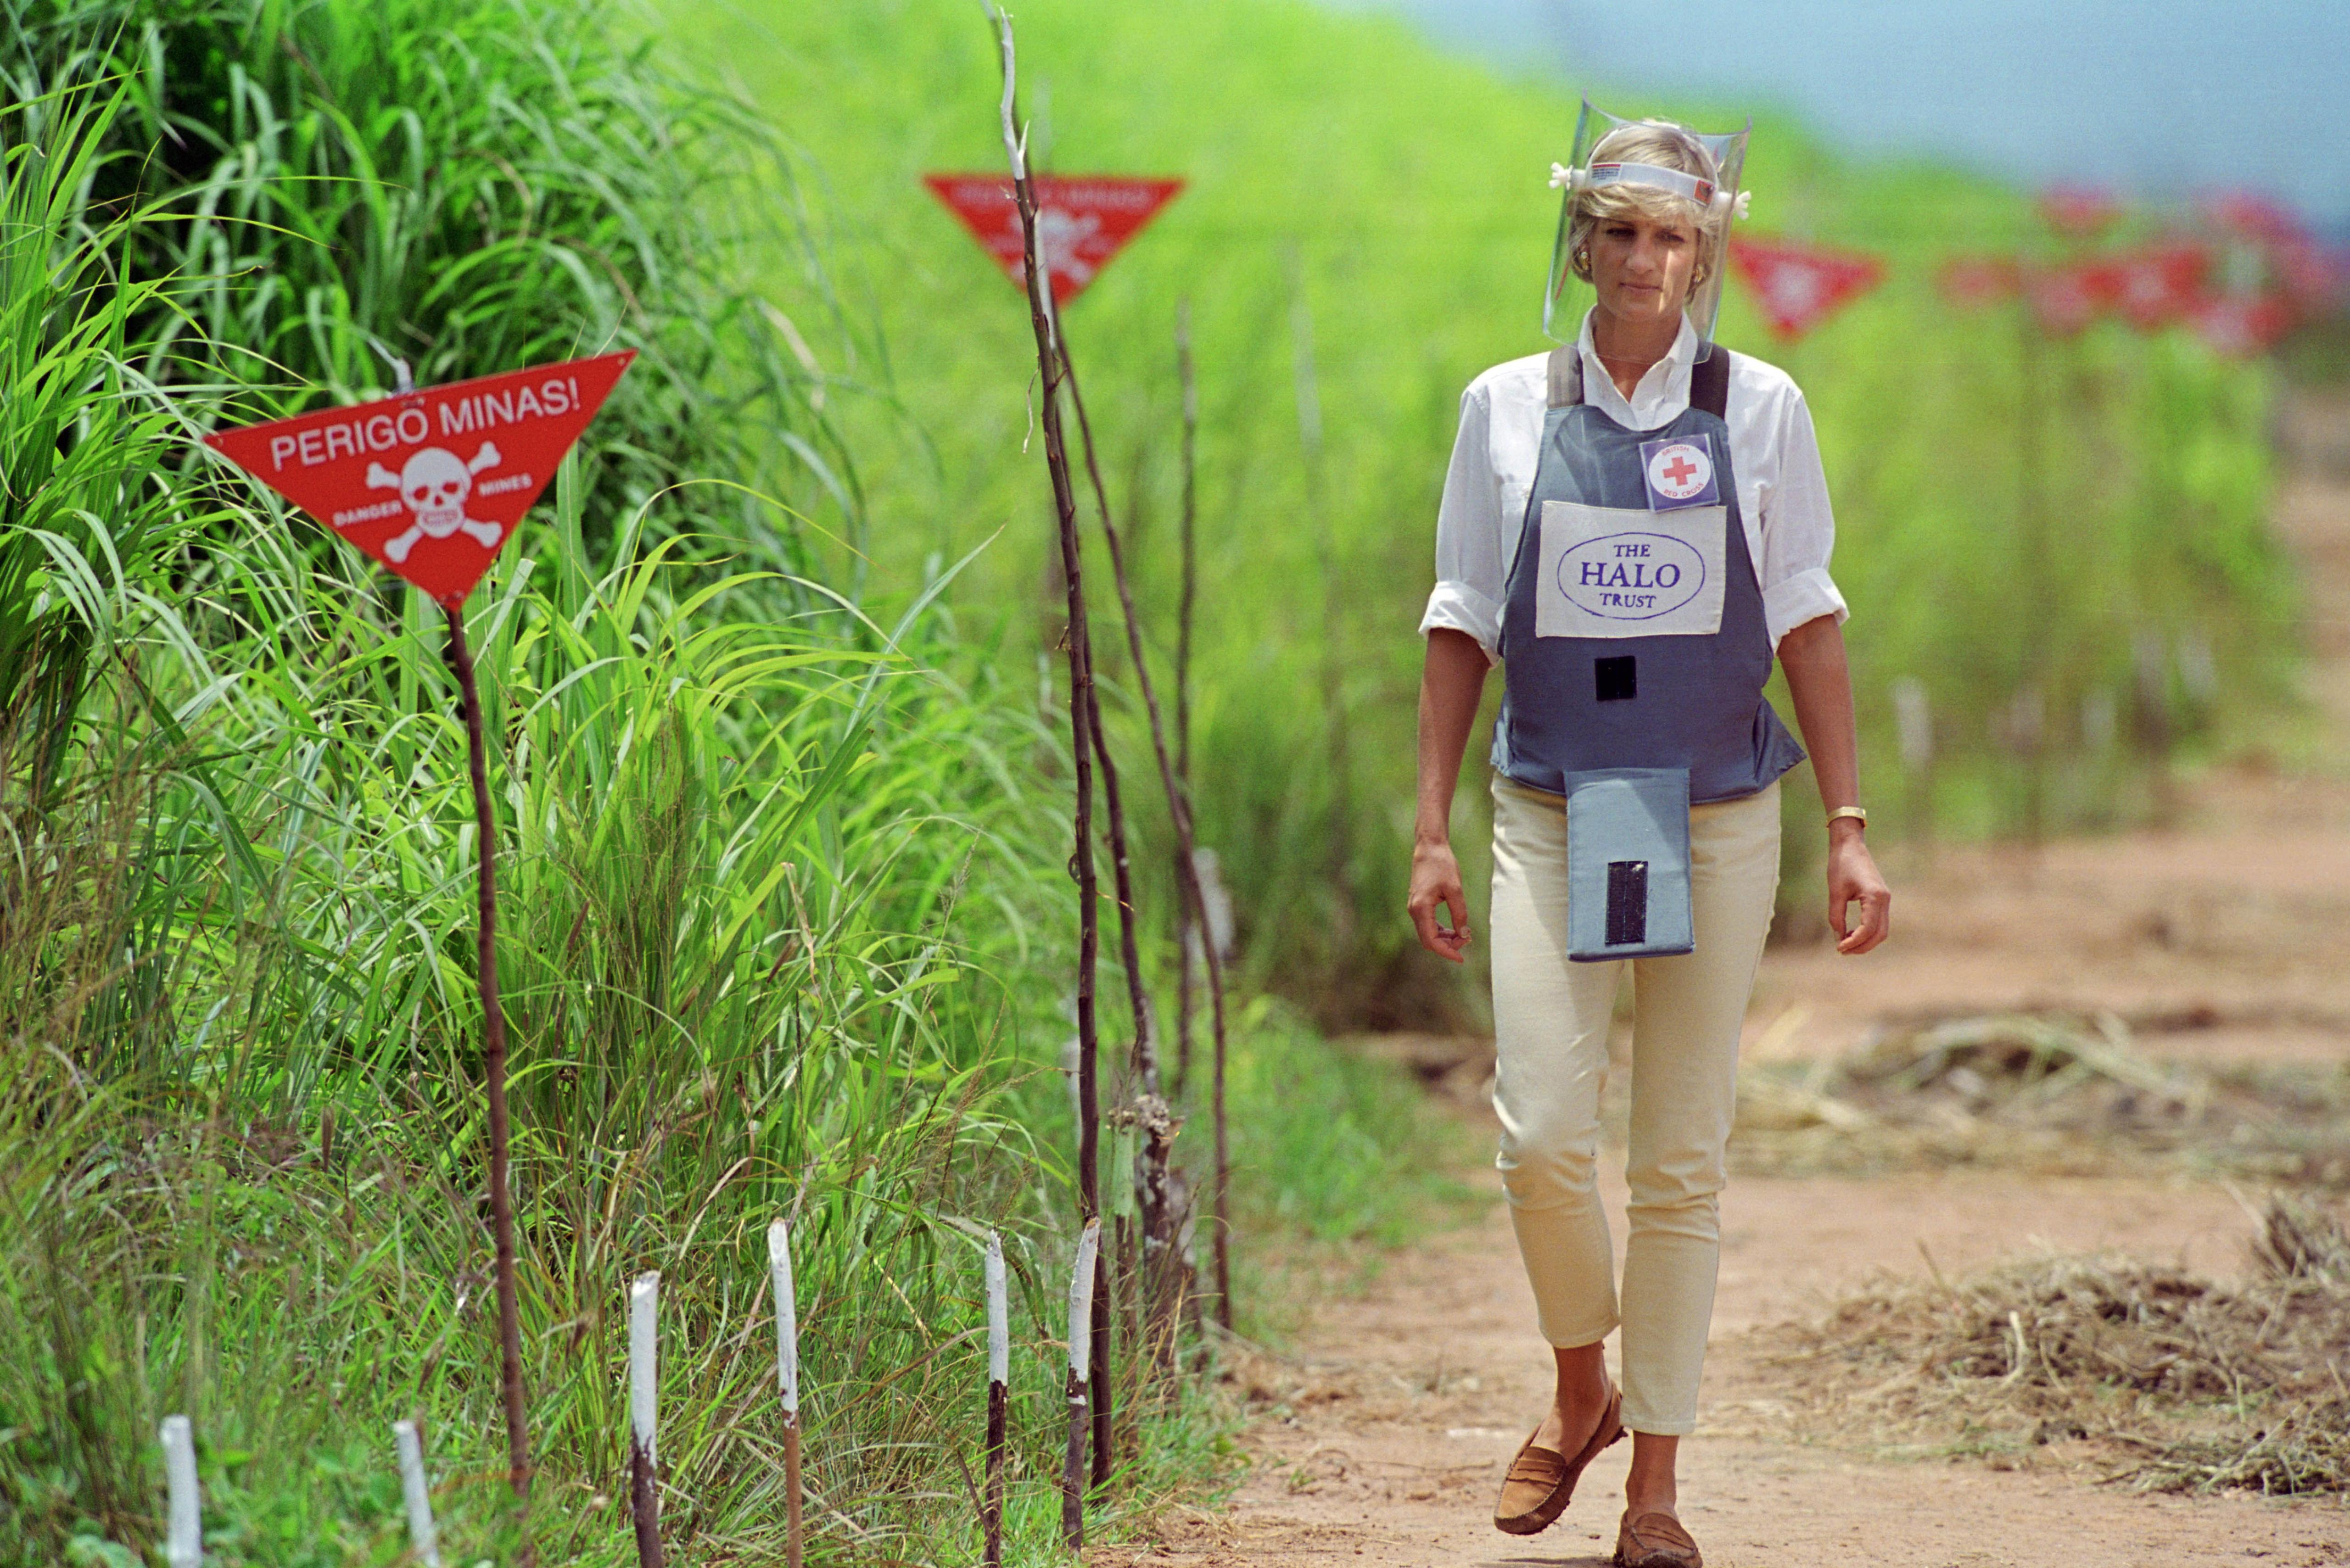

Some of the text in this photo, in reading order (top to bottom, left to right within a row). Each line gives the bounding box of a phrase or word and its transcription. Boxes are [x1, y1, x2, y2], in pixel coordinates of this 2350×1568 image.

[270, 376, 580, 472] PERIGO MINAS!
[1662, 446, 1690, 456] BRITISH
[1663, 482, 1704, 497] RED CROSS
[333, 473, 532, 526] DANGER MINES
[1613, 544, 1651, 557] THE
[1578, 562, 1680, 588] HALO
[1599, 593, 1656, 608] TRUST
